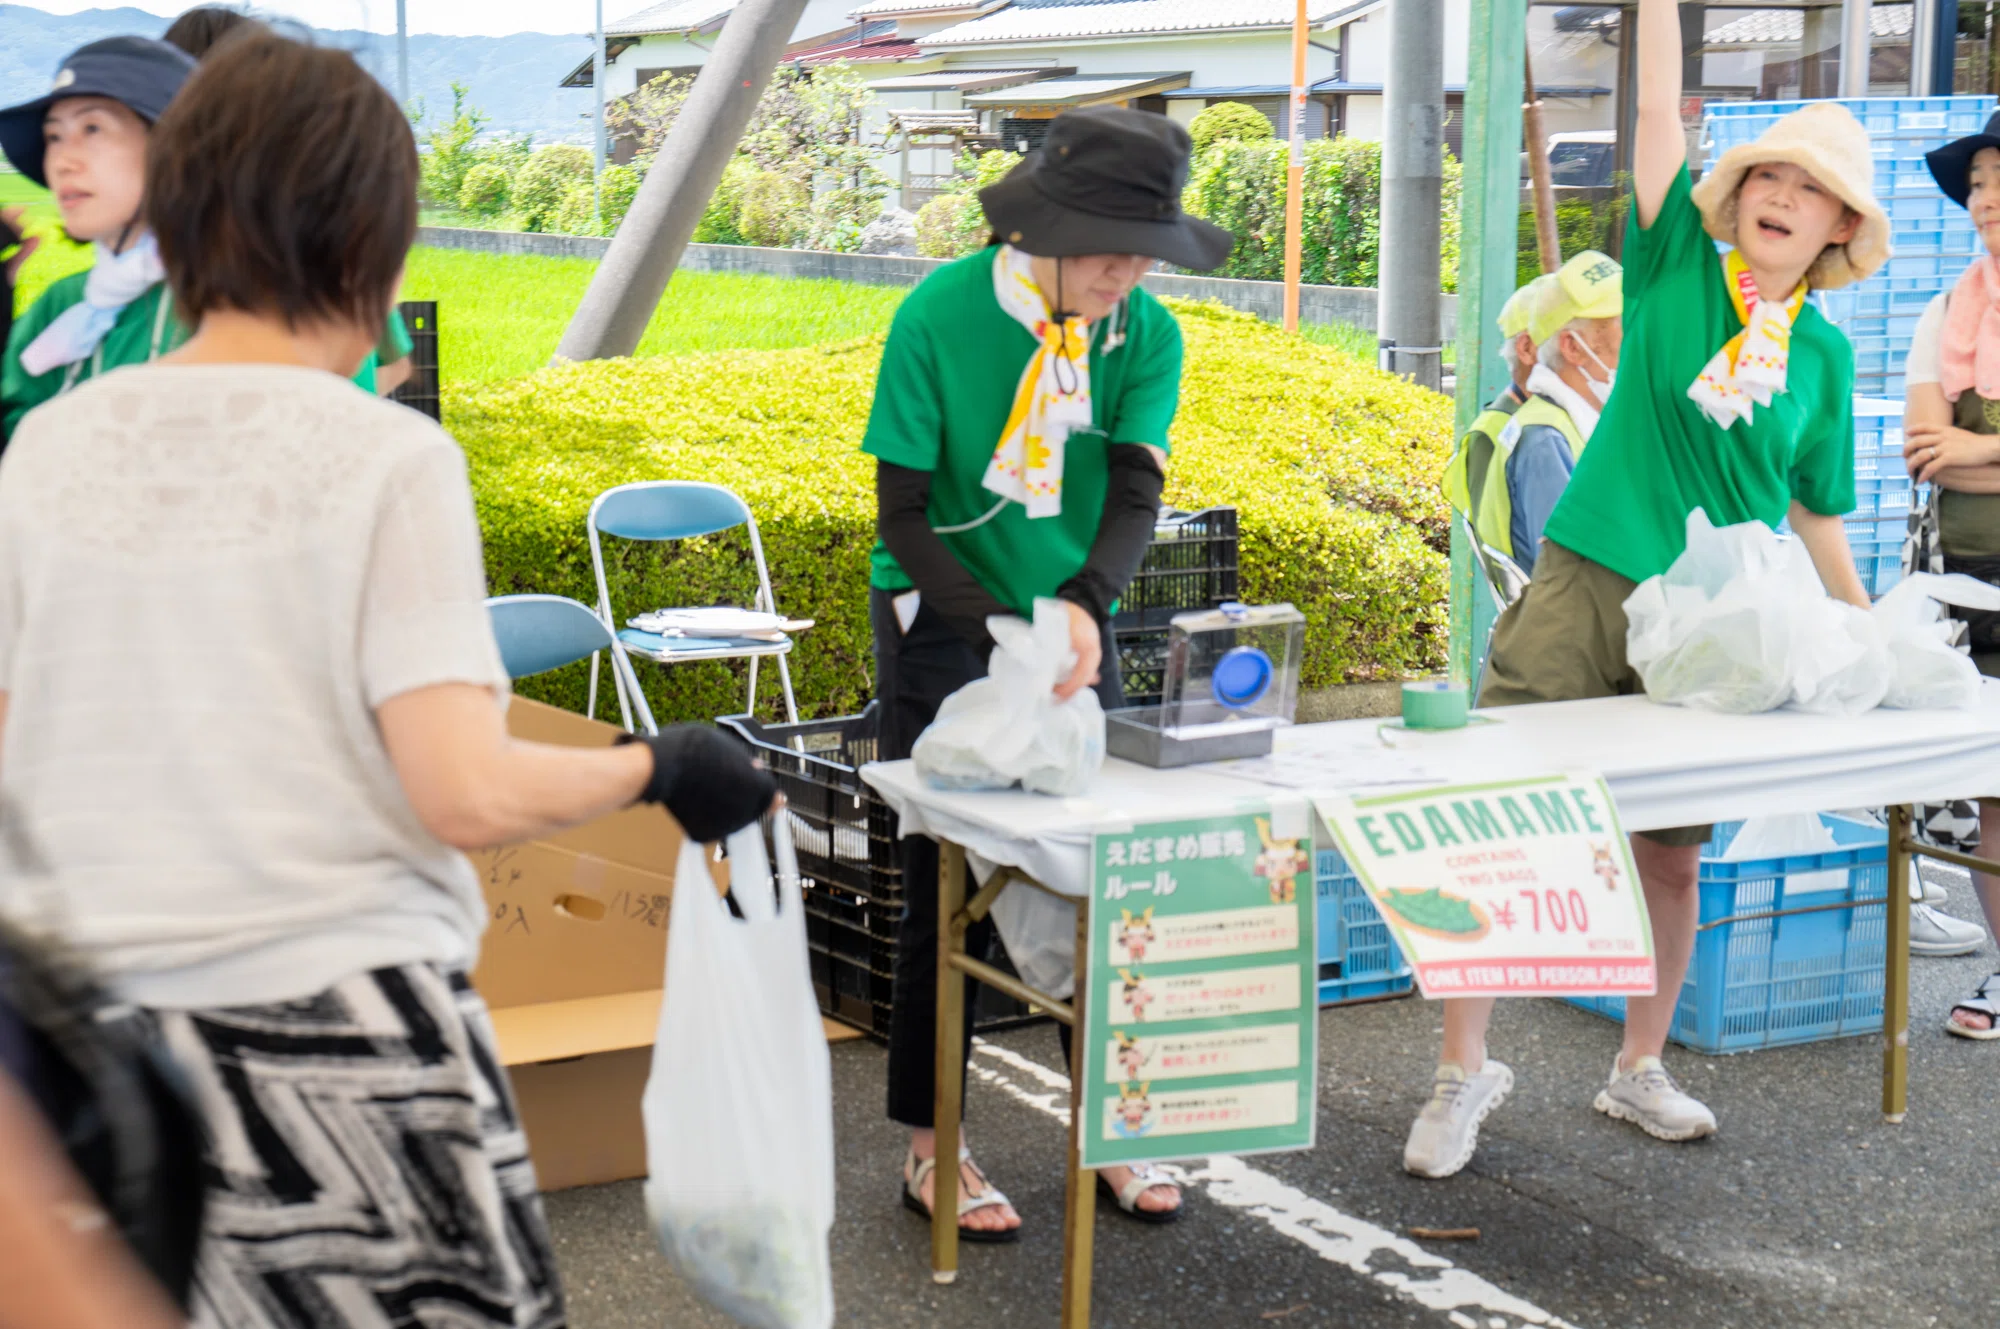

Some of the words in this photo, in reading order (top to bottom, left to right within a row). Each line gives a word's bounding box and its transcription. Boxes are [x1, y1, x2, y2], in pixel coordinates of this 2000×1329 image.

[1356, 787, 1604, 858] EDAMAME
[1105, 829, 1246, 867] えだまめ販売
[1445, 848, 1528, 869] CONTAINS
[1103, 870, 1178, 900] ルール
[1455, 871, 1494, 888] TWO
[1495, 867, 1538, 885] BAGS
[1488, 888, 1589, 933] ¥700
[1425, 967, 1465, 988] ONE
[1466, 966, 1505, 987] ITEM
[1506, 965, 1537, 986] PER
